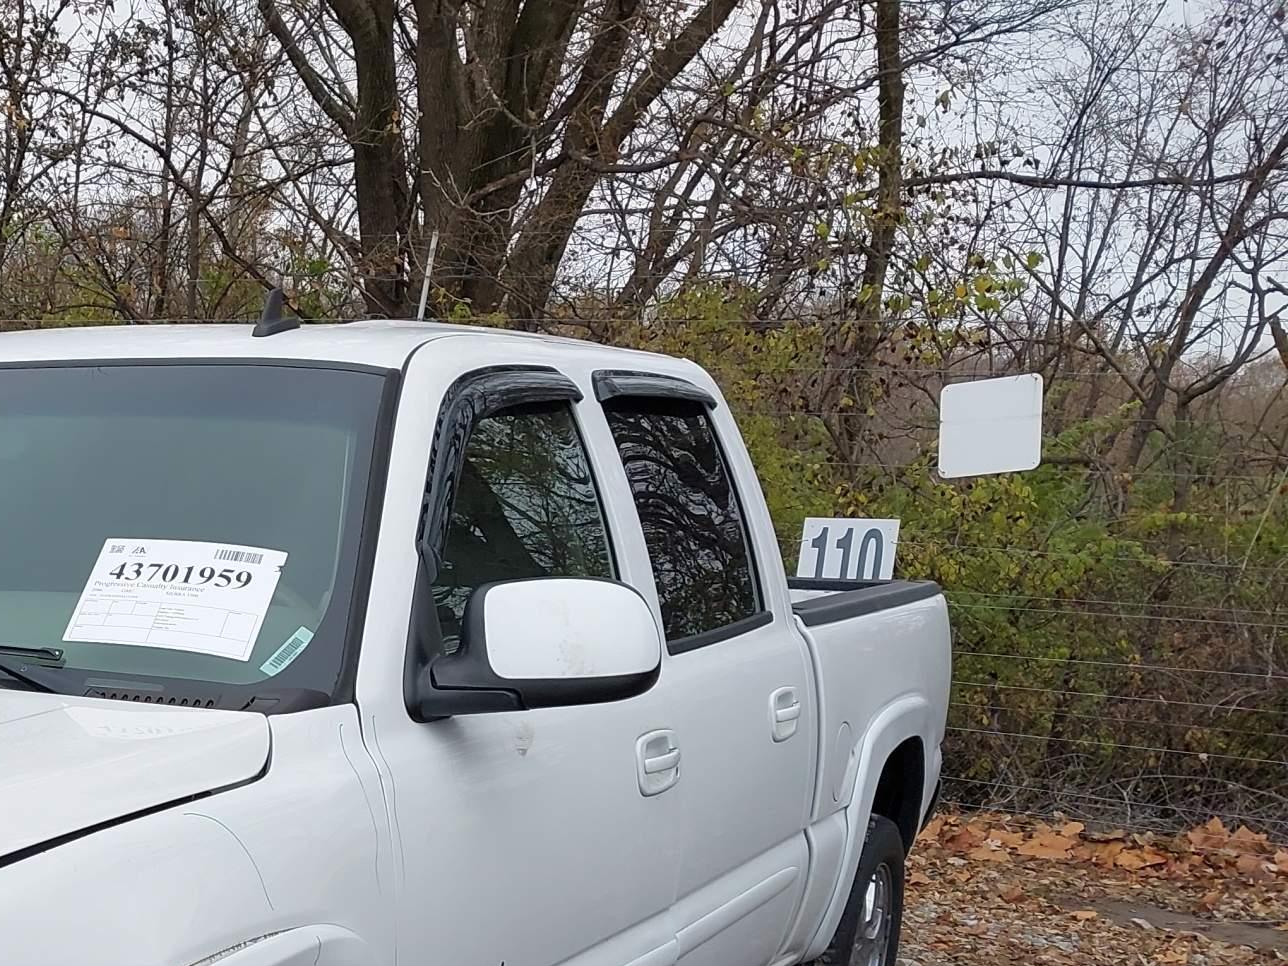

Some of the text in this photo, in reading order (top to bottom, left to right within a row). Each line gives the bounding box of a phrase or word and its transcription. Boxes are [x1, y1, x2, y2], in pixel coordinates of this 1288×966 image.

[812, 527, 884, 580] 110
[109, 561, 253, 590] 43701959
[136, 582, 166, 590] Casualty
[169, 584, 205, 592] Insurance
